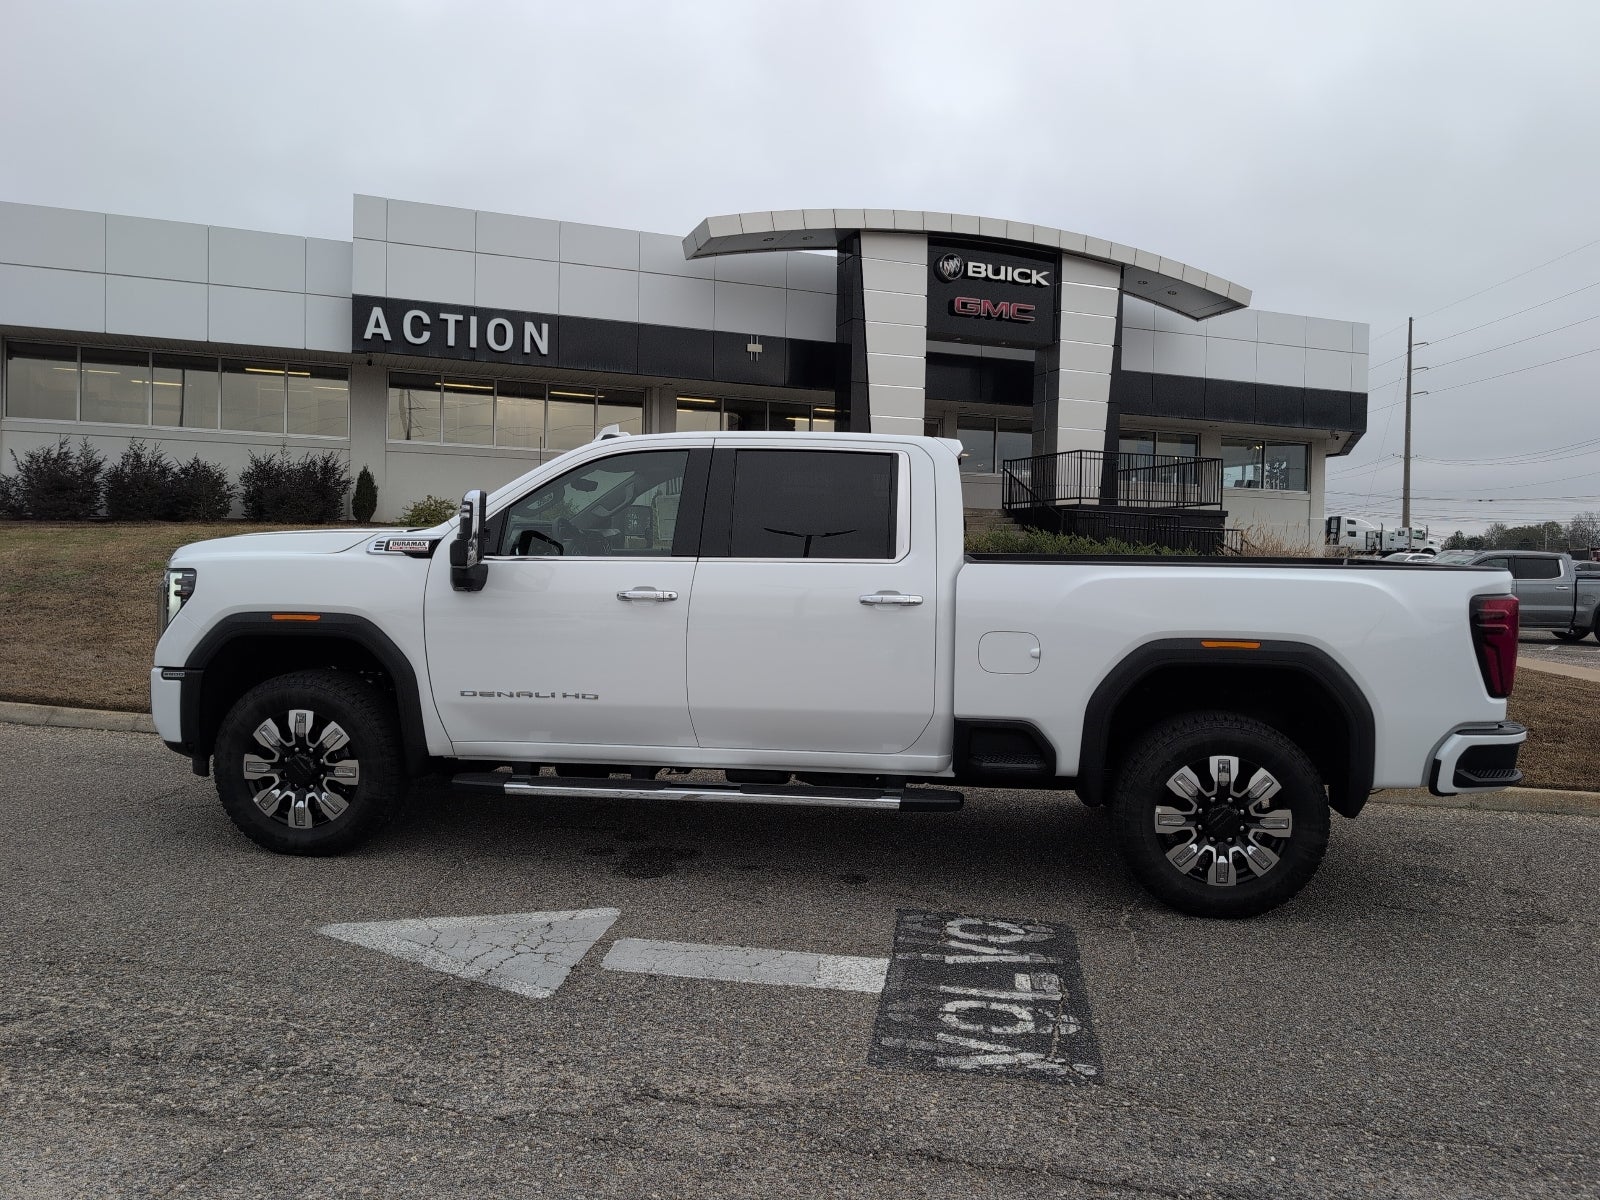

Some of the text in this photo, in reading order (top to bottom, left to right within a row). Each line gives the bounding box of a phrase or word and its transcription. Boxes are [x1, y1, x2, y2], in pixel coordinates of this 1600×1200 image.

[967, 261, 1050, 286] BUICK
[954, 296, 1036, 322] GMC
[363, 306, 549, 355] ACTION
[460, 690, 599, 700] DENALI HD
